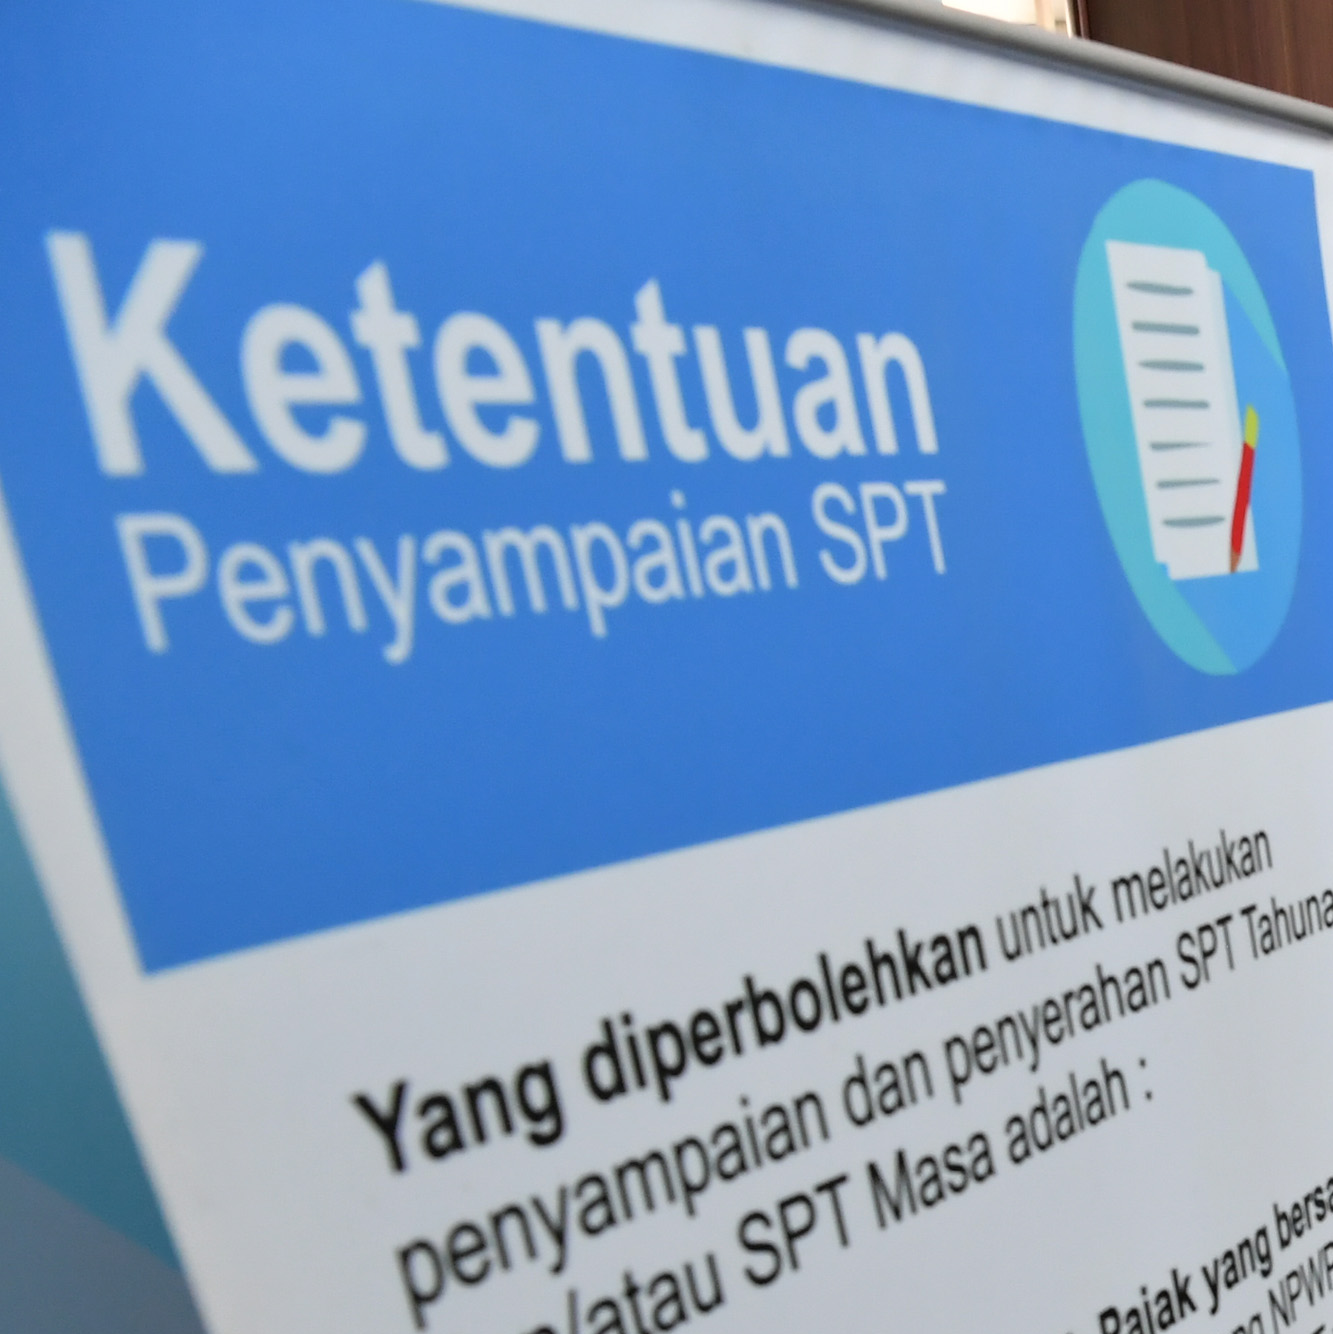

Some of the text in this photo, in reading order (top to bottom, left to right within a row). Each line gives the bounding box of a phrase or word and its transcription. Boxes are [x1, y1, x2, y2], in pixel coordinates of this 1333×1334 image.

[46, 229, 938, 477] Ketentuan
[115, 481, 947, 664] Penyampaian SPT
[351, 831, 1272, 1174] Yang diperbolehkan untuk melakukan
[396, 1092, 829, 1331] penyampaian
[843, 1051, 933, 1127] dan
[944, 959, 1170, 1104] penyerahan
[1177, 914, 1233, 989] SPT
[737, 1174, 849, 1287] SPT
[867, 1132, 995, 1229] Masa
[1006, 1059, 1129, 1164] adalah
[1202, 1226, 1272, 1315] yang
